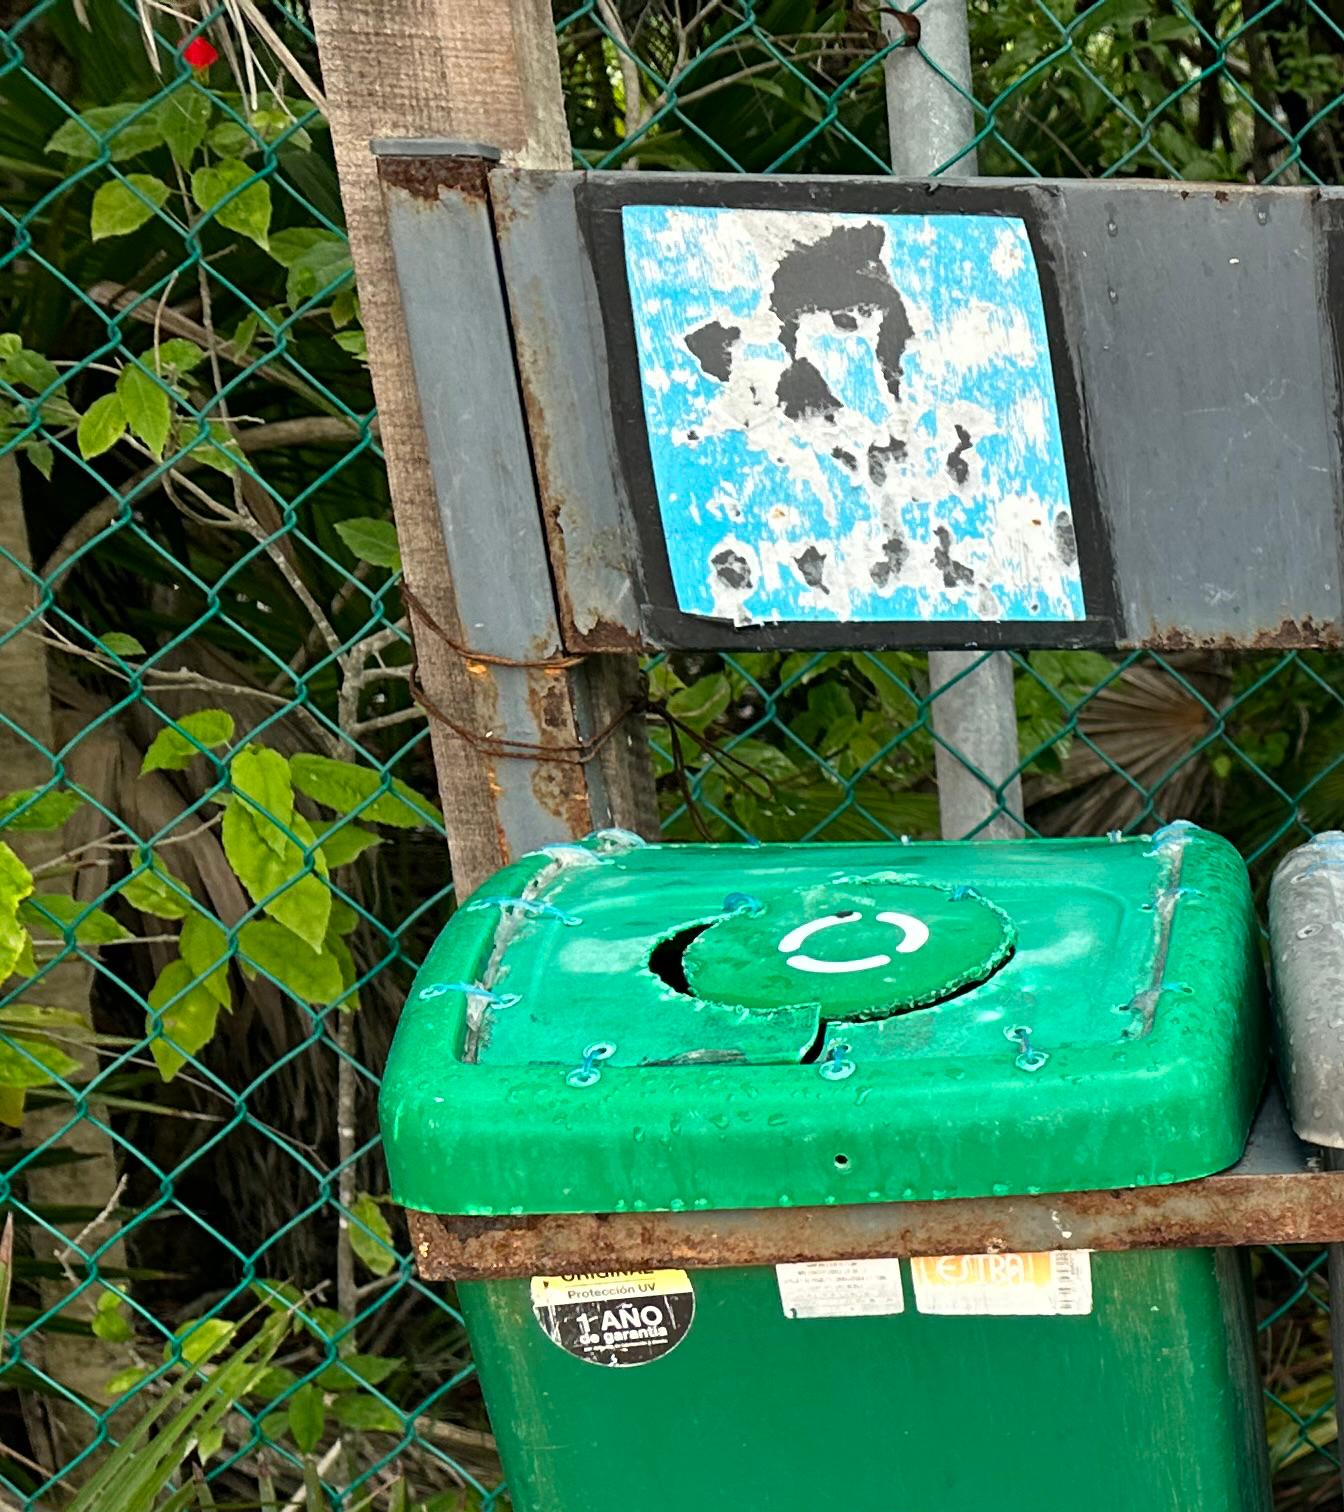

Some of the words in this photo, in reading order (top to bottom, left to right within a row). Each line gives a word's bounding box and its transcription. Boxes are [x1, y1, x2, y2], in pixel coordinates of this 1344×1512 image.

[567, 1285, 636, 1299] Protección
[638, 1282, 656, 1292] UV
[601, 1303, 663, 1331] AÑO
